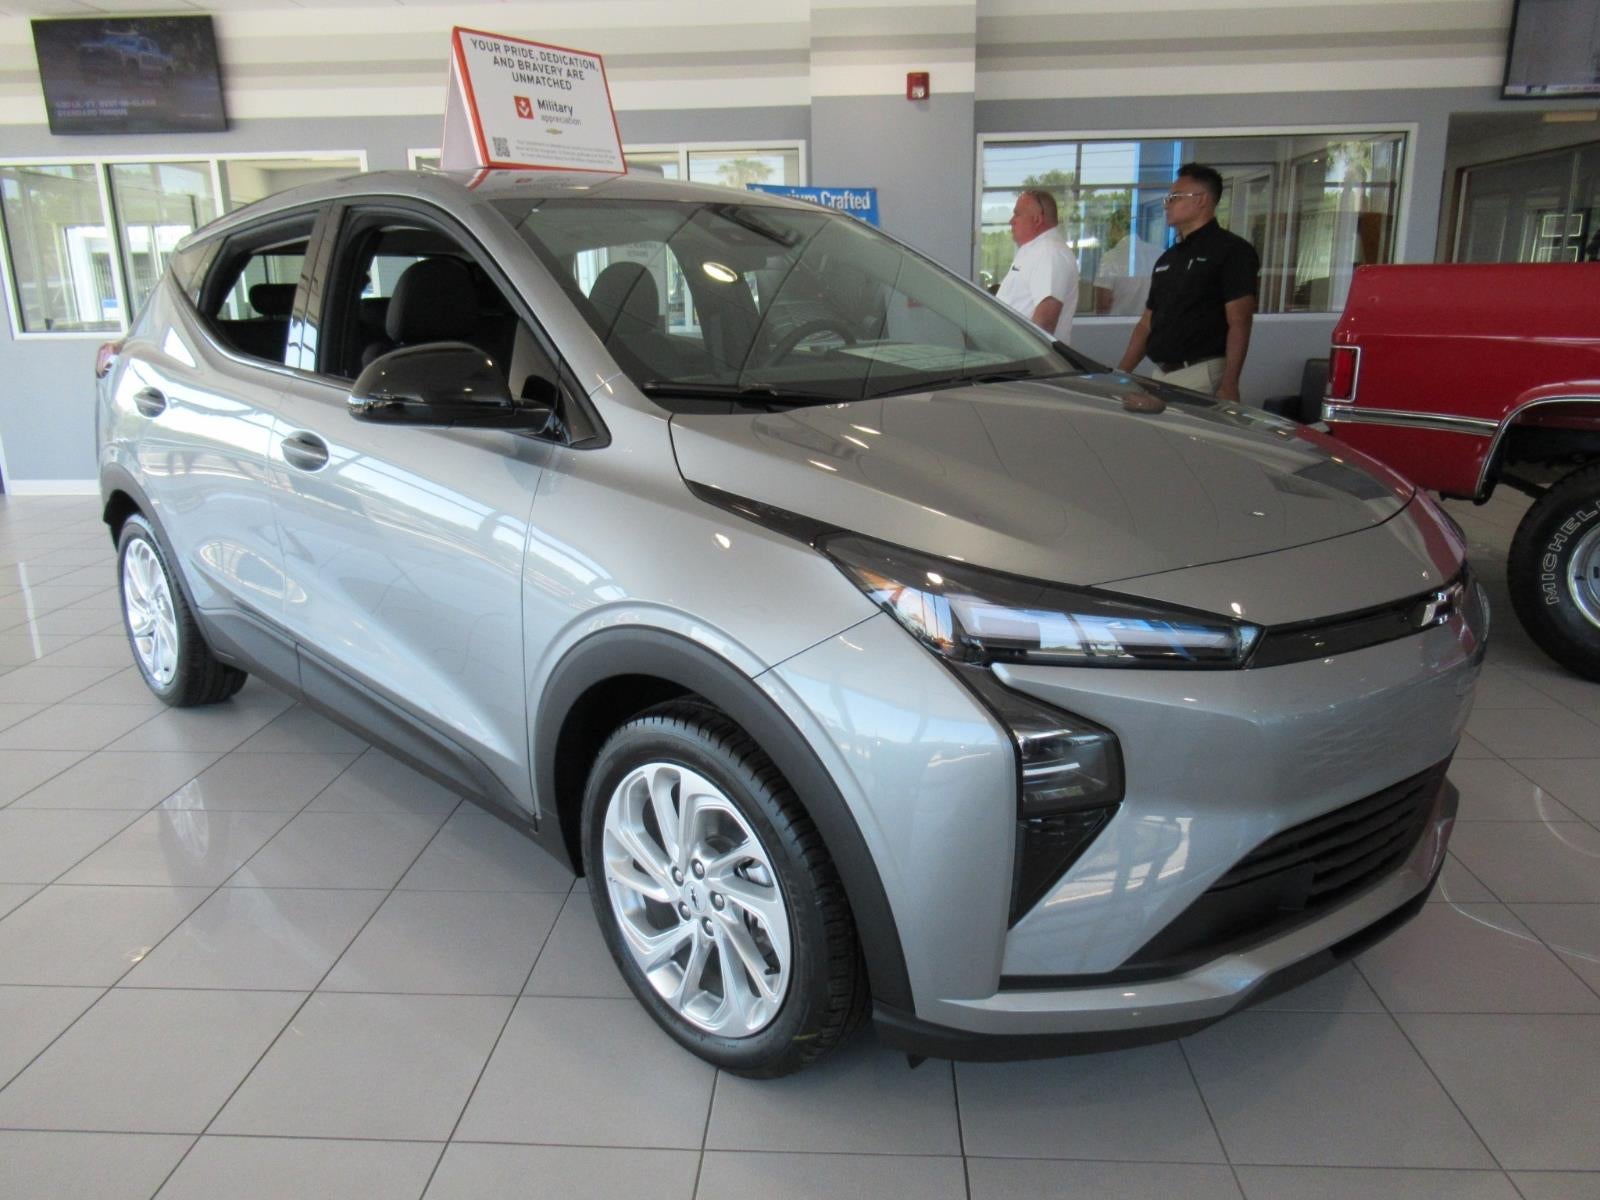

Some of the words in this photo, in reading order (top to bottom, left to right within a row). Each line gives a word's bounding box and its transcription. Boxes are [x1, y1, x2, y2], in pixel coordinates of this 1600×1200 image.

[470, 38, 501, 54] YOUR
[504, 44, 539, 61] PRIDE,
[540, 51, 599, 72] DEDICATION,
[493, 55, 515, 69] AND
[517, 59, 563, 76] BRAVERY
[566, 68, 585, 81] ARE
[511, 71, 572, 91] UNMATCHED
[536, 98, 573, 118] Military
[820, 190, 871, 210] Crafted
